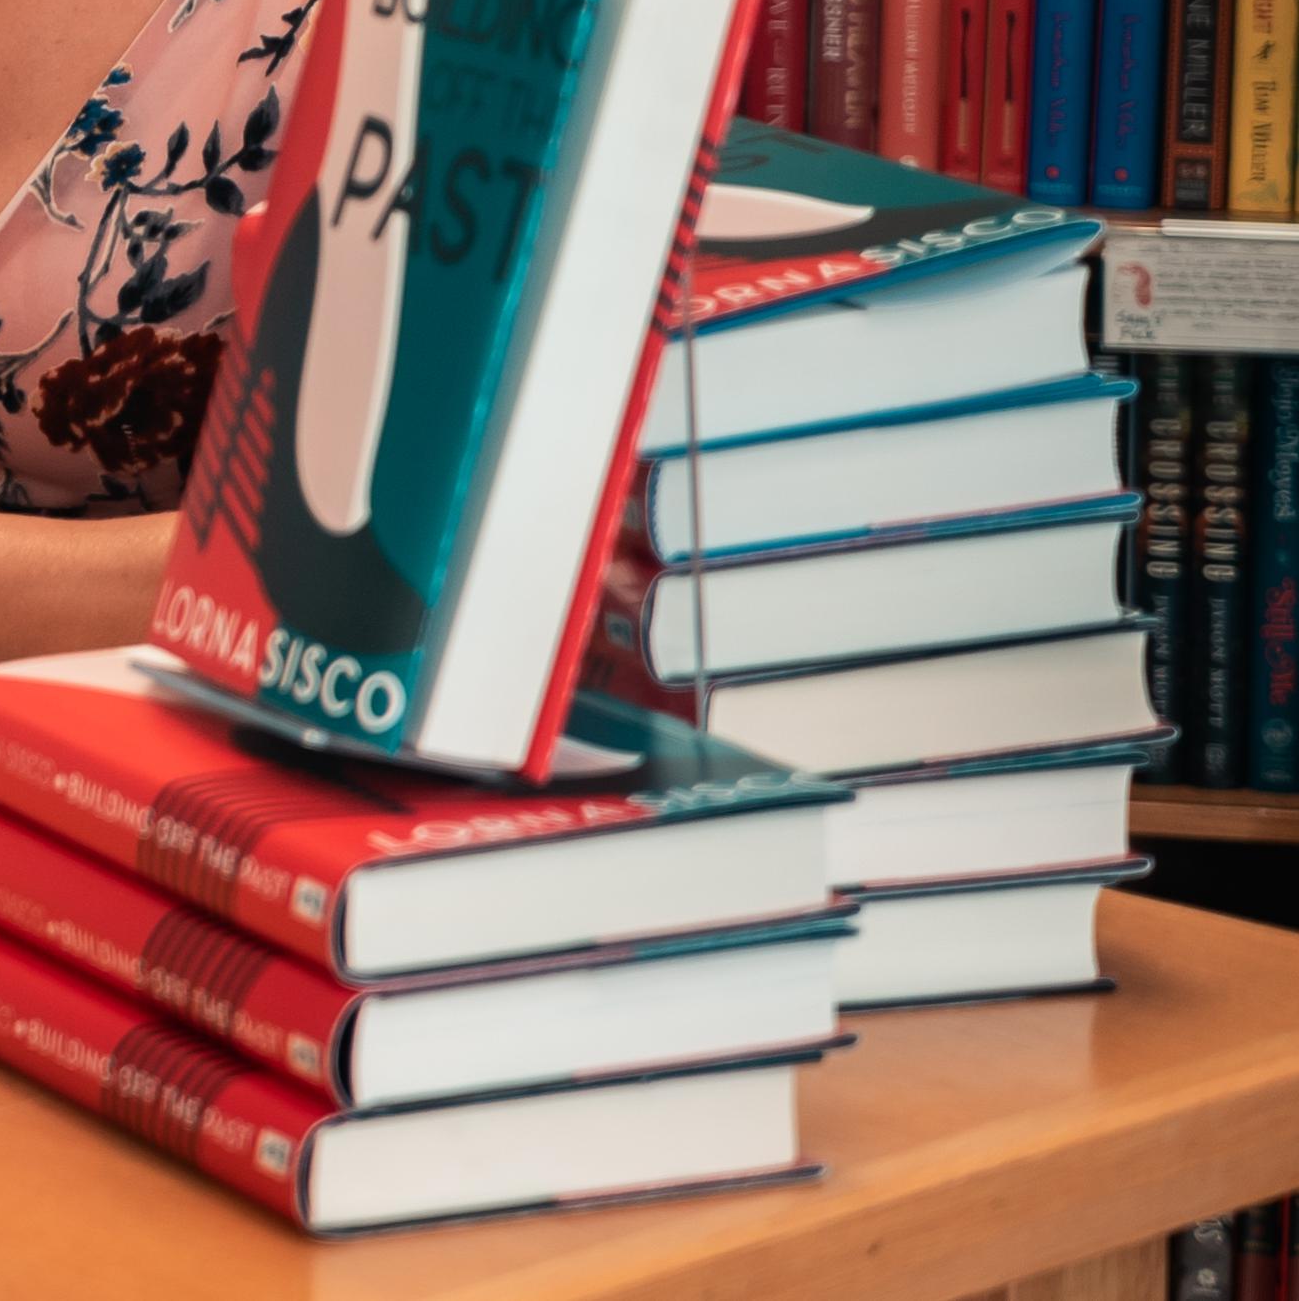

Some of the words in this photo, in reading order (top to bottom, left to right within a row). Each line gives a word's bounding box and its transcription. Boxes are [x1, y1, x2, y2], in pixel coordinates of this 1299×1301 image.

[1182, 37, 1213, 139] MILLER
[331, 113, 545, 285] PAST
[860, 206, 1067, 267] SISCO
[1146, 417, 1185, 580] CROSSING
[1202, 419, 1242, 583] CROSSING
[153, 578, 260, 675] LORNA
[258, 627, 408, 735] SISCO
[66, 770, 157, 840] BUILDING
[27, 1018, 116, 1089] BUILDING
